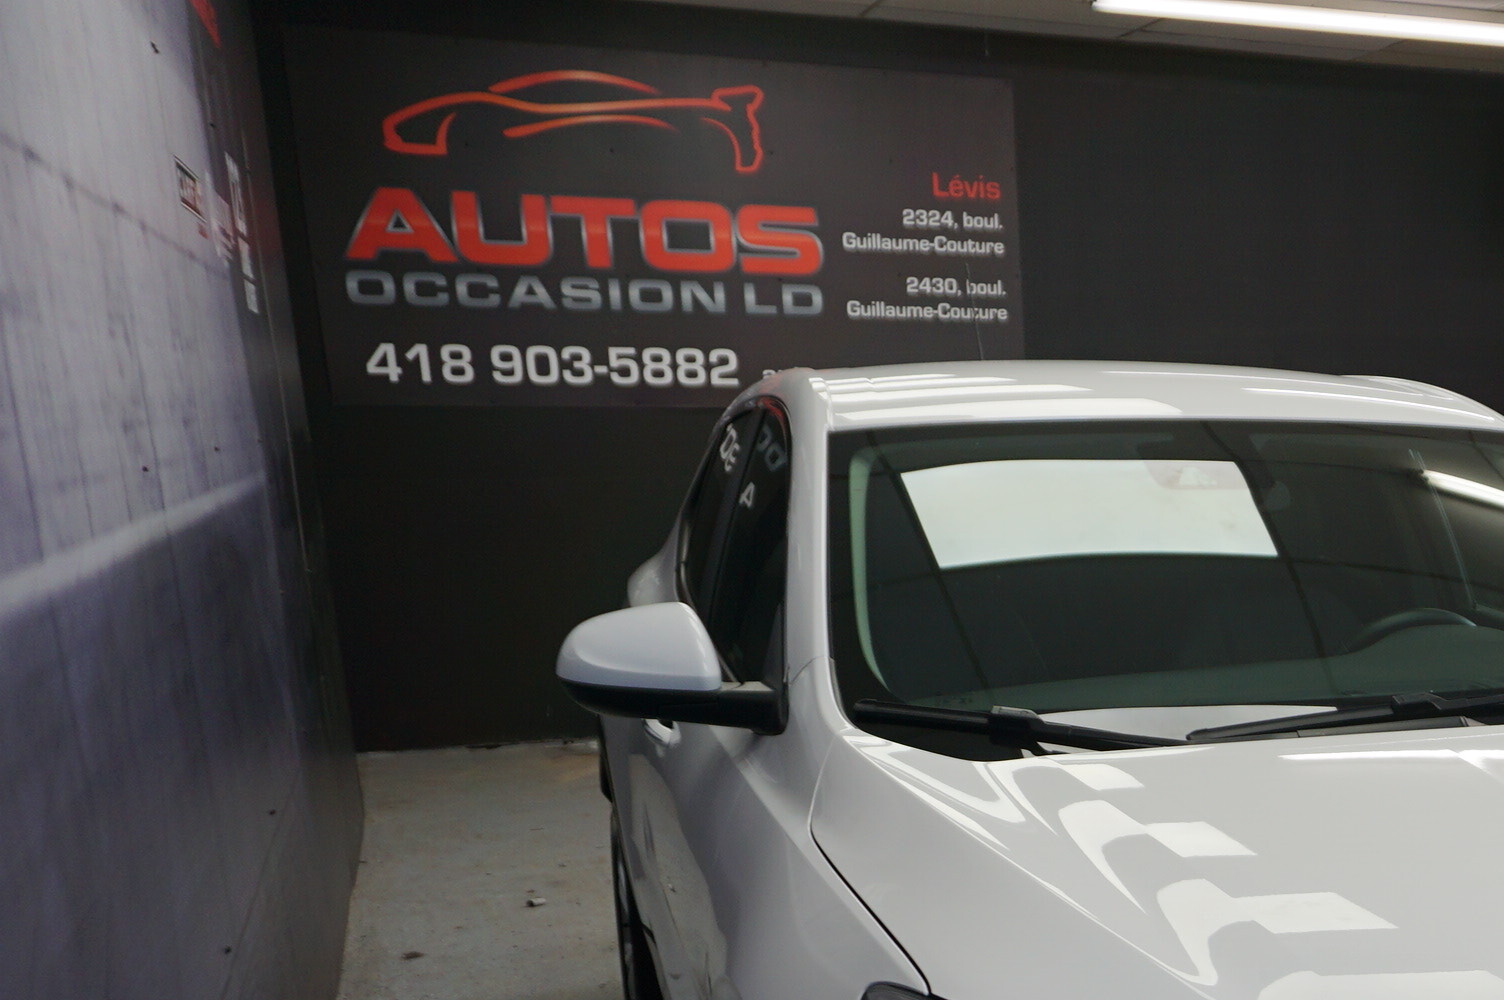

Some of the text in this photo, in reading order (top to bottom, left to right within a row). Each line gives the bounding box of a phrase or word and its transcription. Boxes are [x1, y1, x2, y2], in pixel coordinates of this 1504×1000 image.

[931, 172, 1002, 199] Lévis
[346, 186, 823, 275] AUTOS
[902, 208, 1003, 229] 2324, boul.
[842, 231, 1005, 254] Guillaume-Couture
[345, 270, 823, 315] OCCASION LD
[906, 276, 962, 296] 2430,
[366, 342, 740, 387] 418 903-5882
